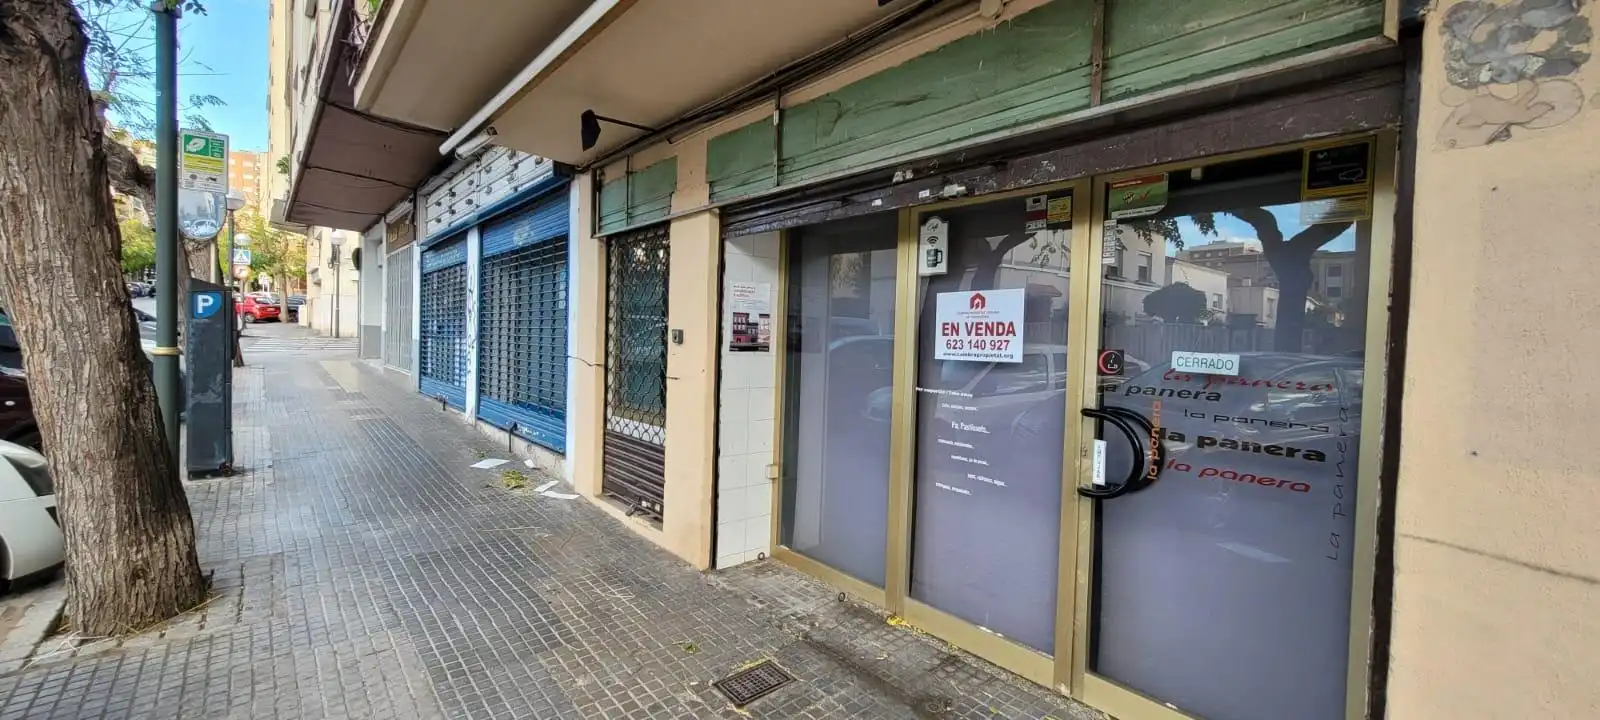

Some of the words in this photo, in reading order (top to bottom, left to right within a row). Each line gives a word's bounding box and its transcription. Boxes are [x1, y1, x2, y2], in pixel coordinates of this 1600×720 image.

[197, 295, 213, 313] P
[942, 322, 960, 337] EN
[965, 321, 1017, 337] VENDA
[946, 339, 964, 350] 623
[968, 339, 986, 350] 140
[990, 340, 1010, 351] 927
[1176, 356, 1235, 371] CERRADO
[1124, 384, 1222, 402] panera
[1150, 400, 1162, 460] panera
[1184, 409, 1205, 419] la
[1214, 414, 1330, 434] panera
[1161, 428, 1186, 443] la
[1197, 435, 1327, 463] panera
[1147, 465, 1158, 479] la
[1333, 407, 1350, 520] panera
[1167, 459, 1192, 472] la
[1198, 467, 1312, 493] panera
